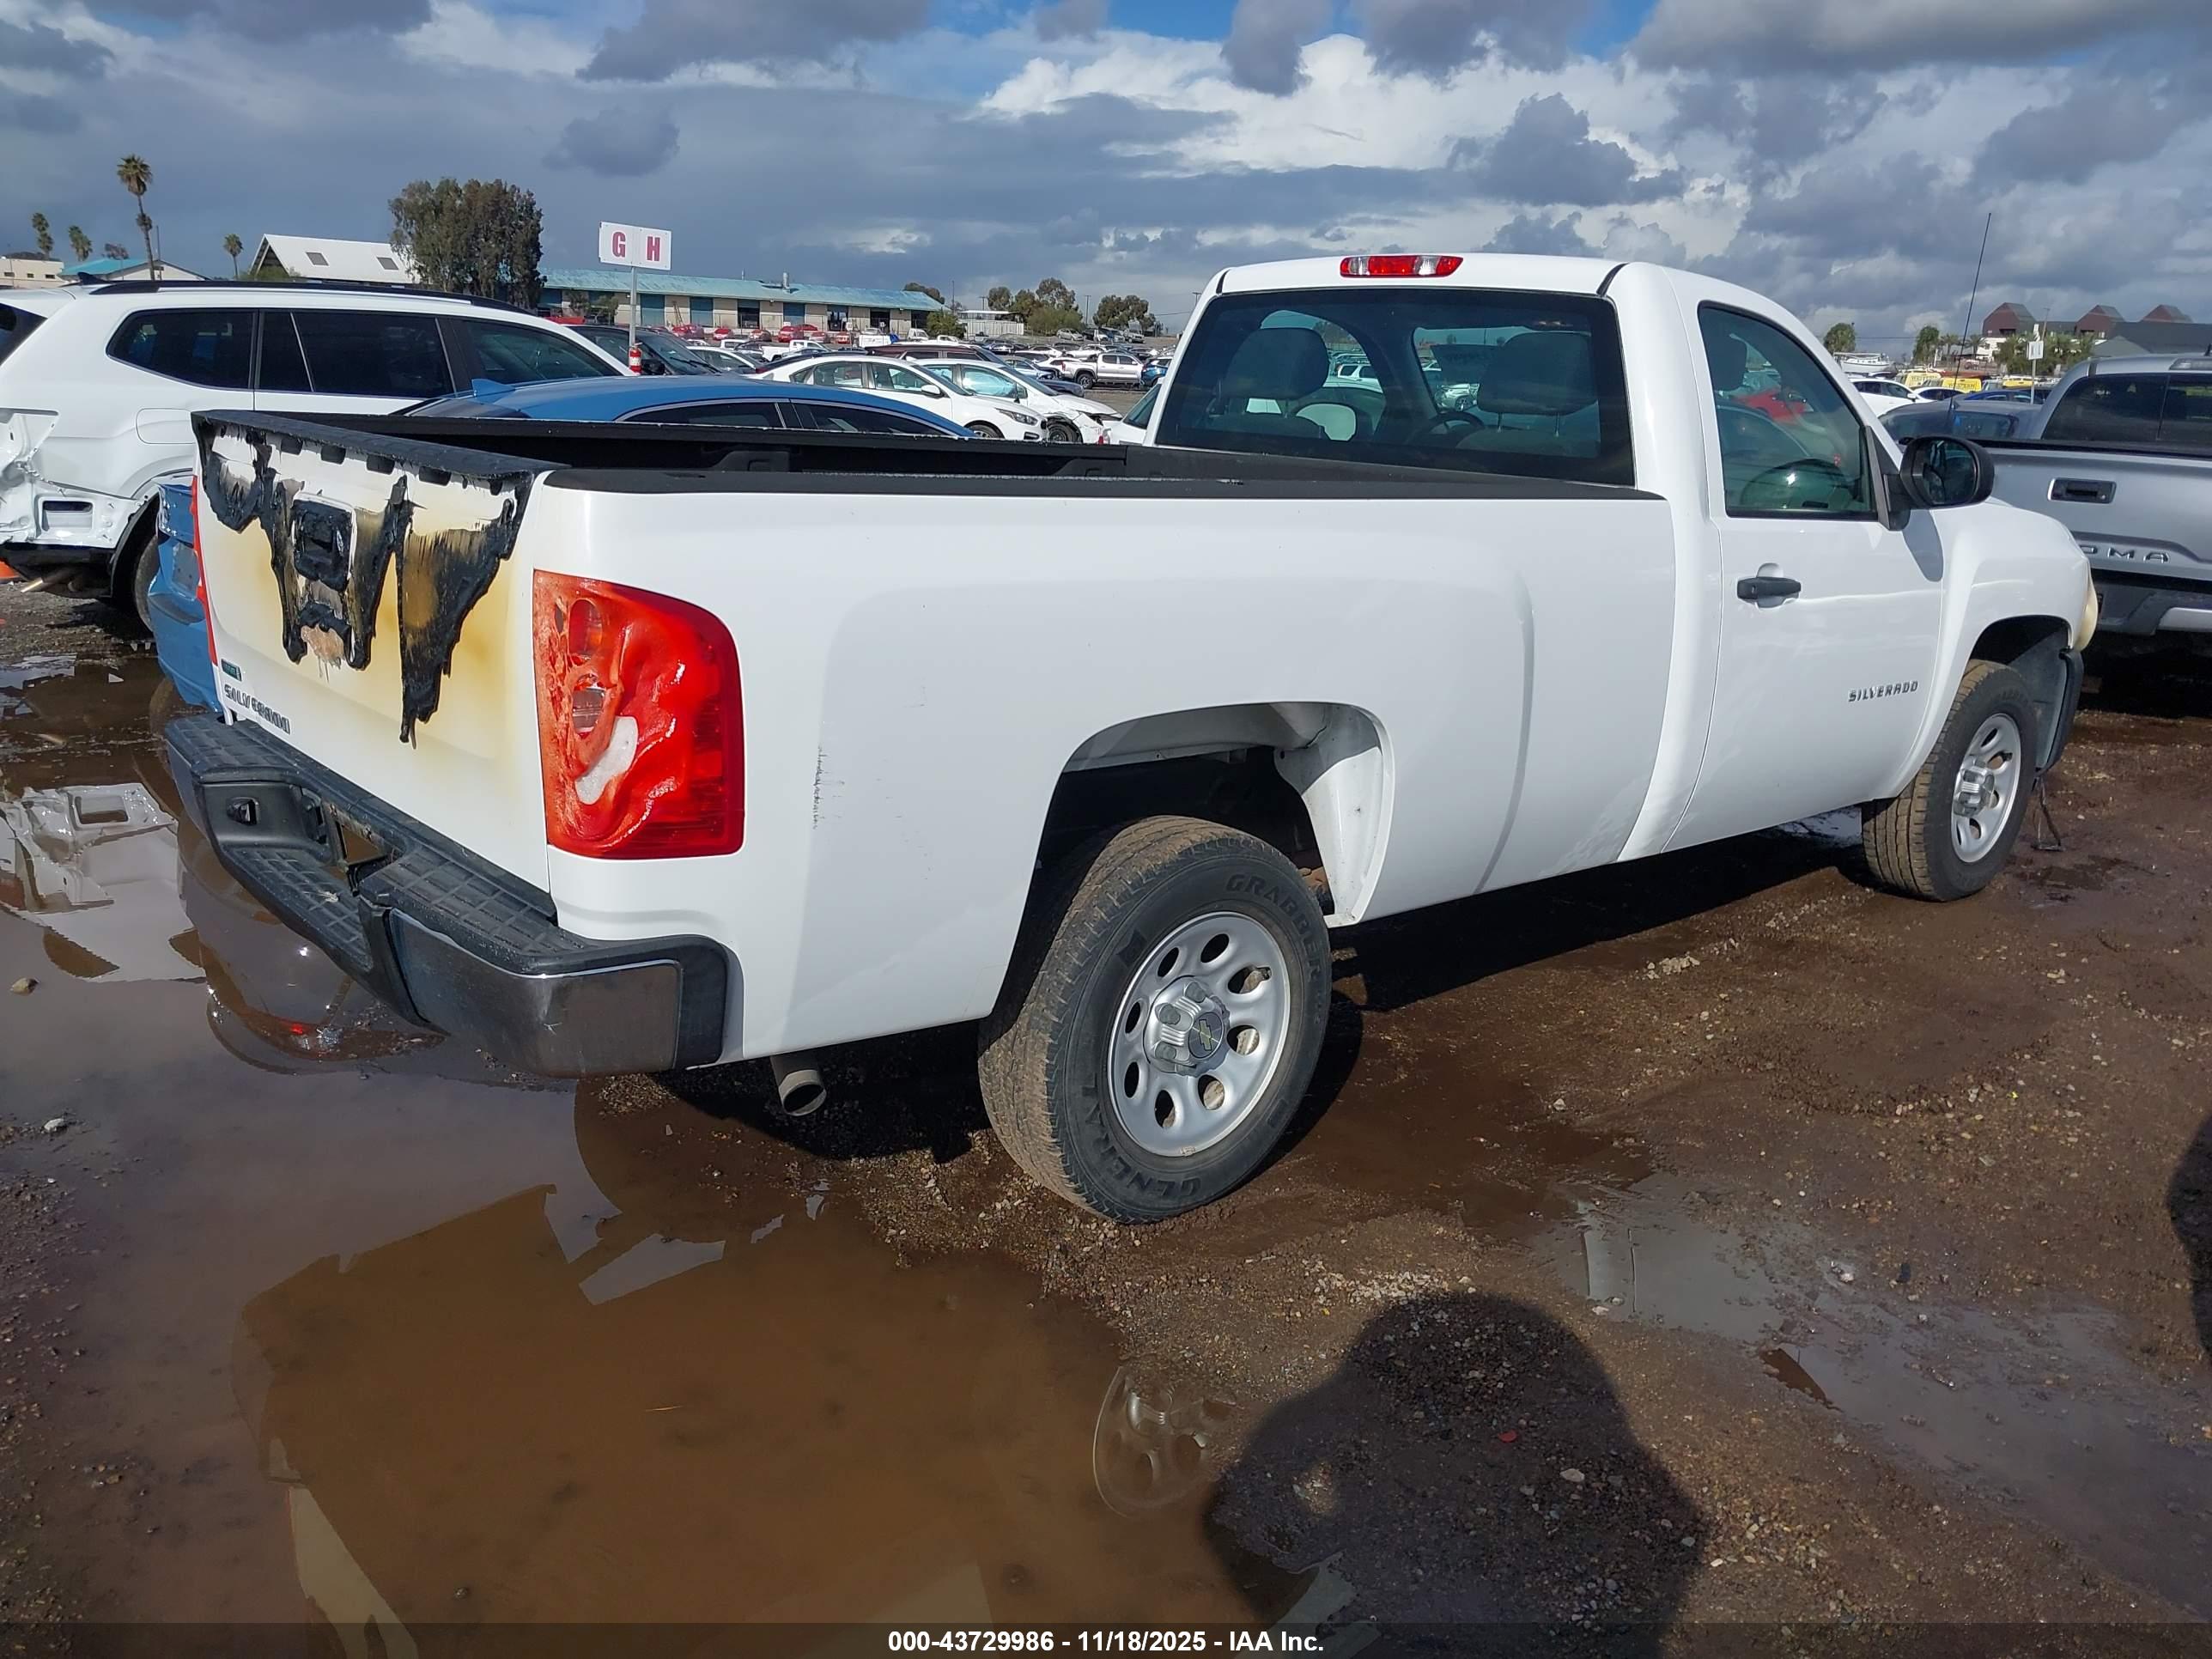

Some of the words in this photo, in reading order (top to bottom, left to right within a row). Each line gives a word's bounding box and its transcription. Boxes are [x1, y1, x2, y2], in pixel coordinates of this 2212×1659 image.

[612, 231, 626, 258] G
[647, 235, 660, 262] H
[1848, 680, 1918, 702] SILVERADO
[1225, 873, 1323, 984] GRABBER
[1080, 1073, 1202, 1197] GENERAL
